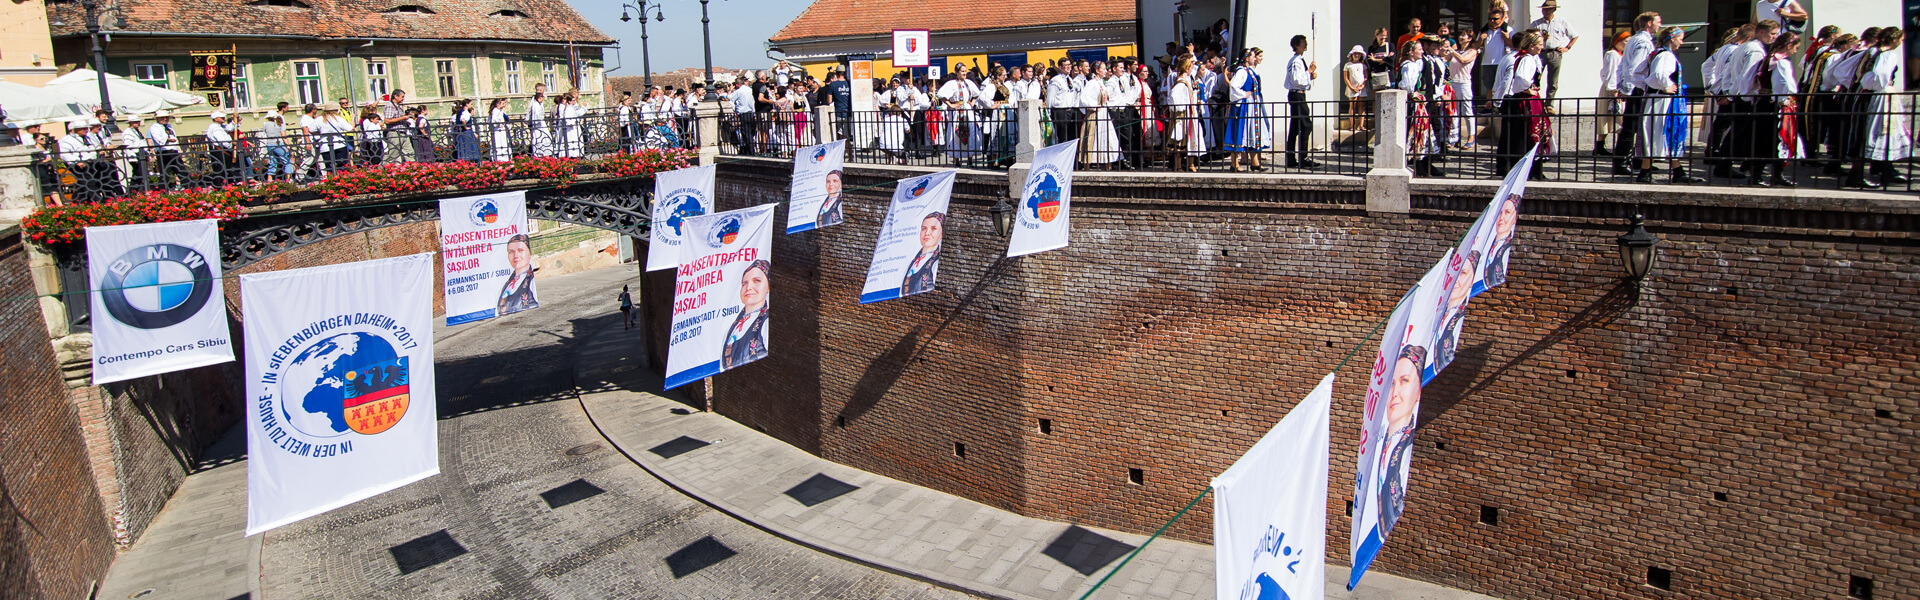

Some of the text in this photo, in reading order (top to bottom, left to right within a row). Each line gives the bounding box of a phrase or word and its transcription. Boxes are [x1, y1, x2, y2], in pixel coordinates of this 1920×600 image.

[932, 69, 937, 77] 6
[444, 224, 518, 245] SACHSENTREFFEN
[110, 246, 204, 277] BMW
[447, 273, 490, 287] HERMANNSTADT
[496, 269, 511, 278] SIBIU
[675, 270, 723, 297] ÎNTÂNIREA
[354, 313, 396, 331] DAHEIM
[673, 310, 715, 334] ERMANNSTADT
[722, 305, 739, 317] SIBIU
[270, 314, 352, 370] SIEBENBÜRGEN
[394, 327, 418, 350] 2017
[99, 338, 227, 365] Contempo Cars Sibiu
[262, 372, 277, 384] IN
[259, 394, 278, 431] HAUSE
[269, 427, 287, 444] ZU
[280, 436, 312, 457] WELT
[313, 445, 337, 458] DER
[341, 440, 353, 454] IN
